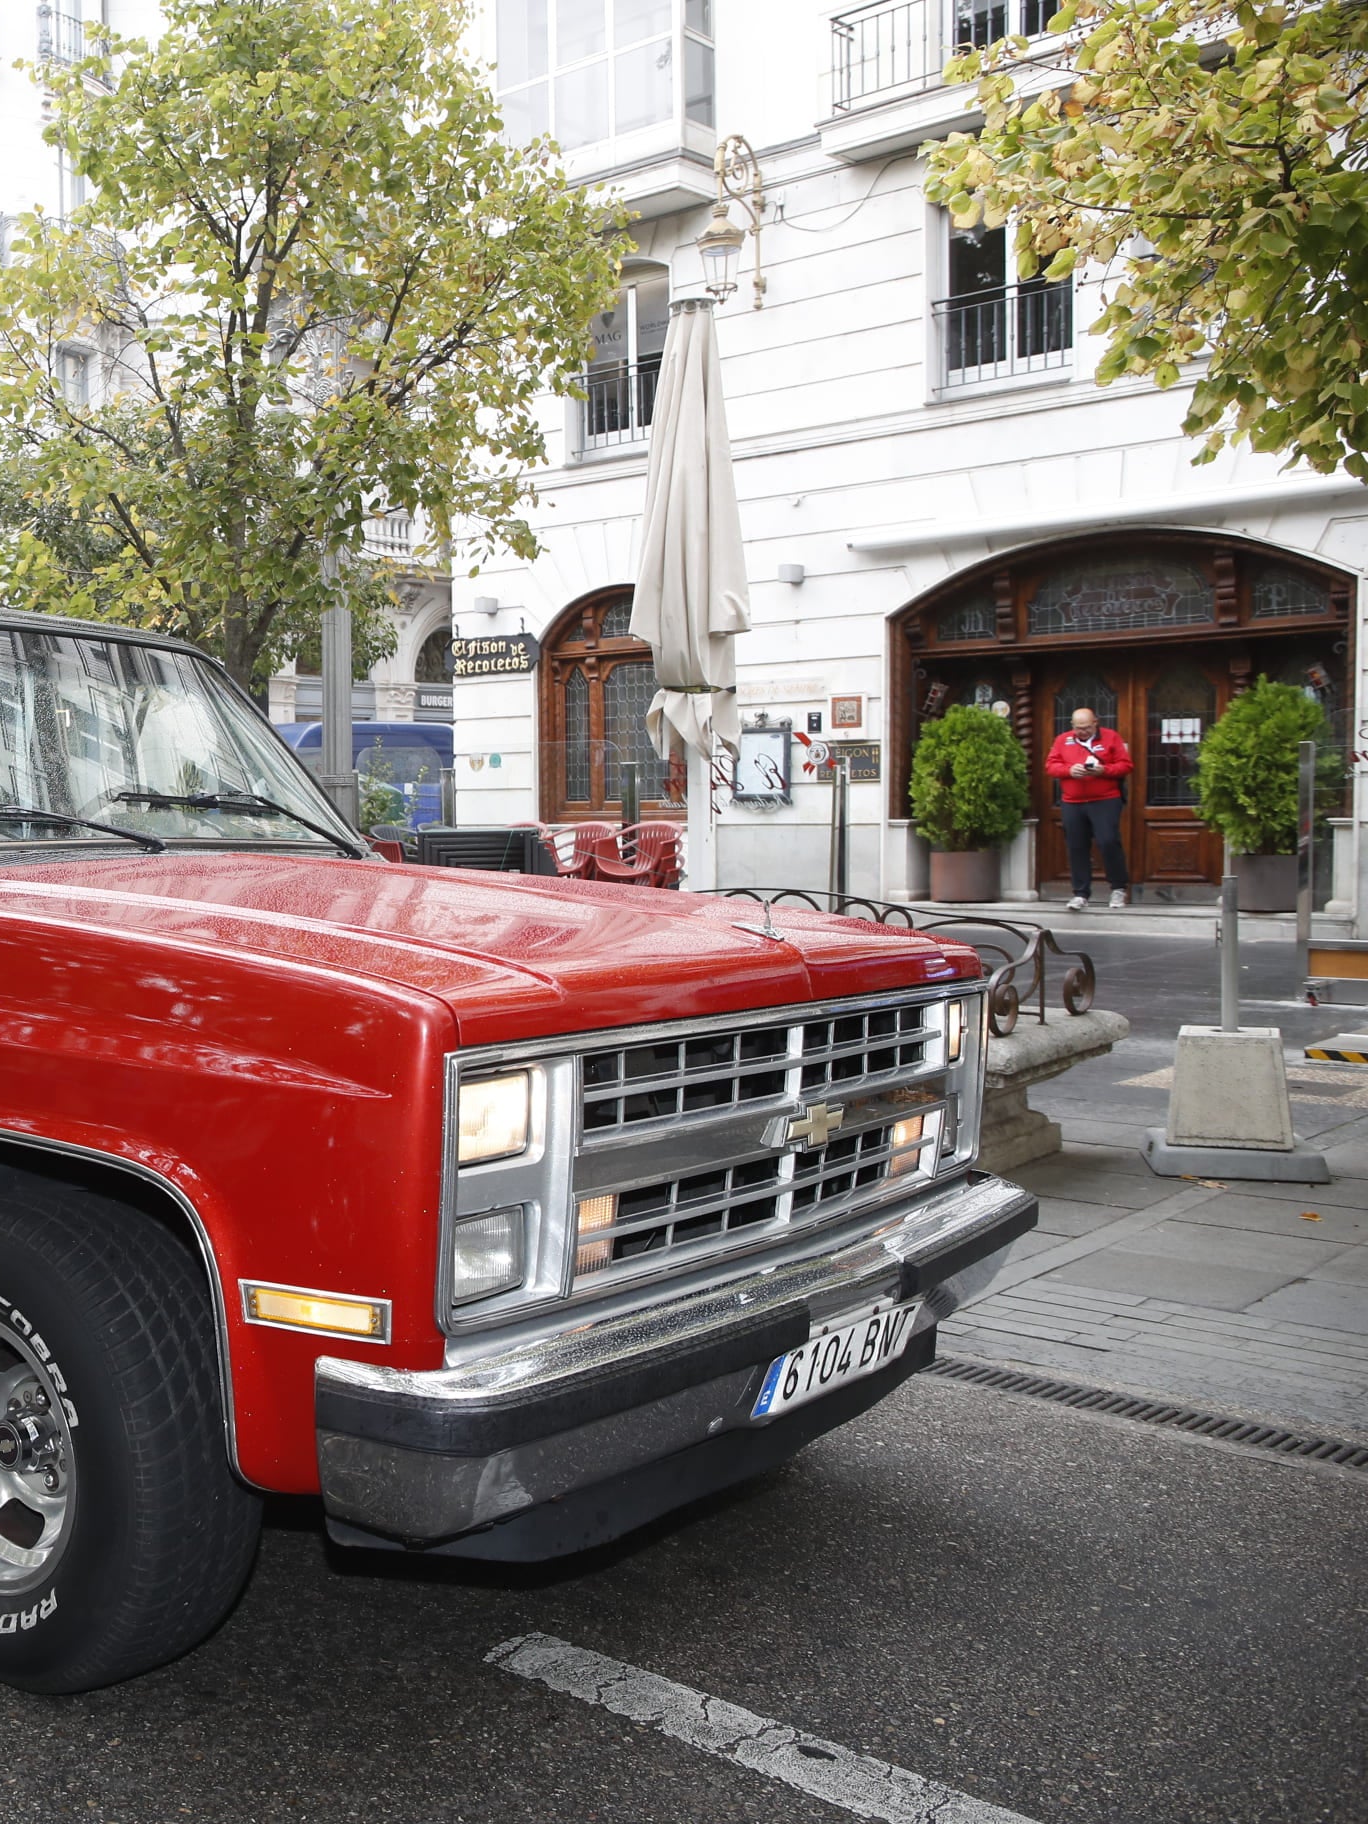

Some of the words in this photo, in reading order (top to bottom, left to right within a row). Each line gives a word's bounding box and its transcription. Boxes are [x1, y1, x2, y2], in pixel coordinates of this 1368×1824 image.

[595, 331, 622, 345] MAG
[454, 655, 530, 675] Recoletos
[783, 1327, 855, 1401] 6104
[859, 1305, 917, 1368] BNT
